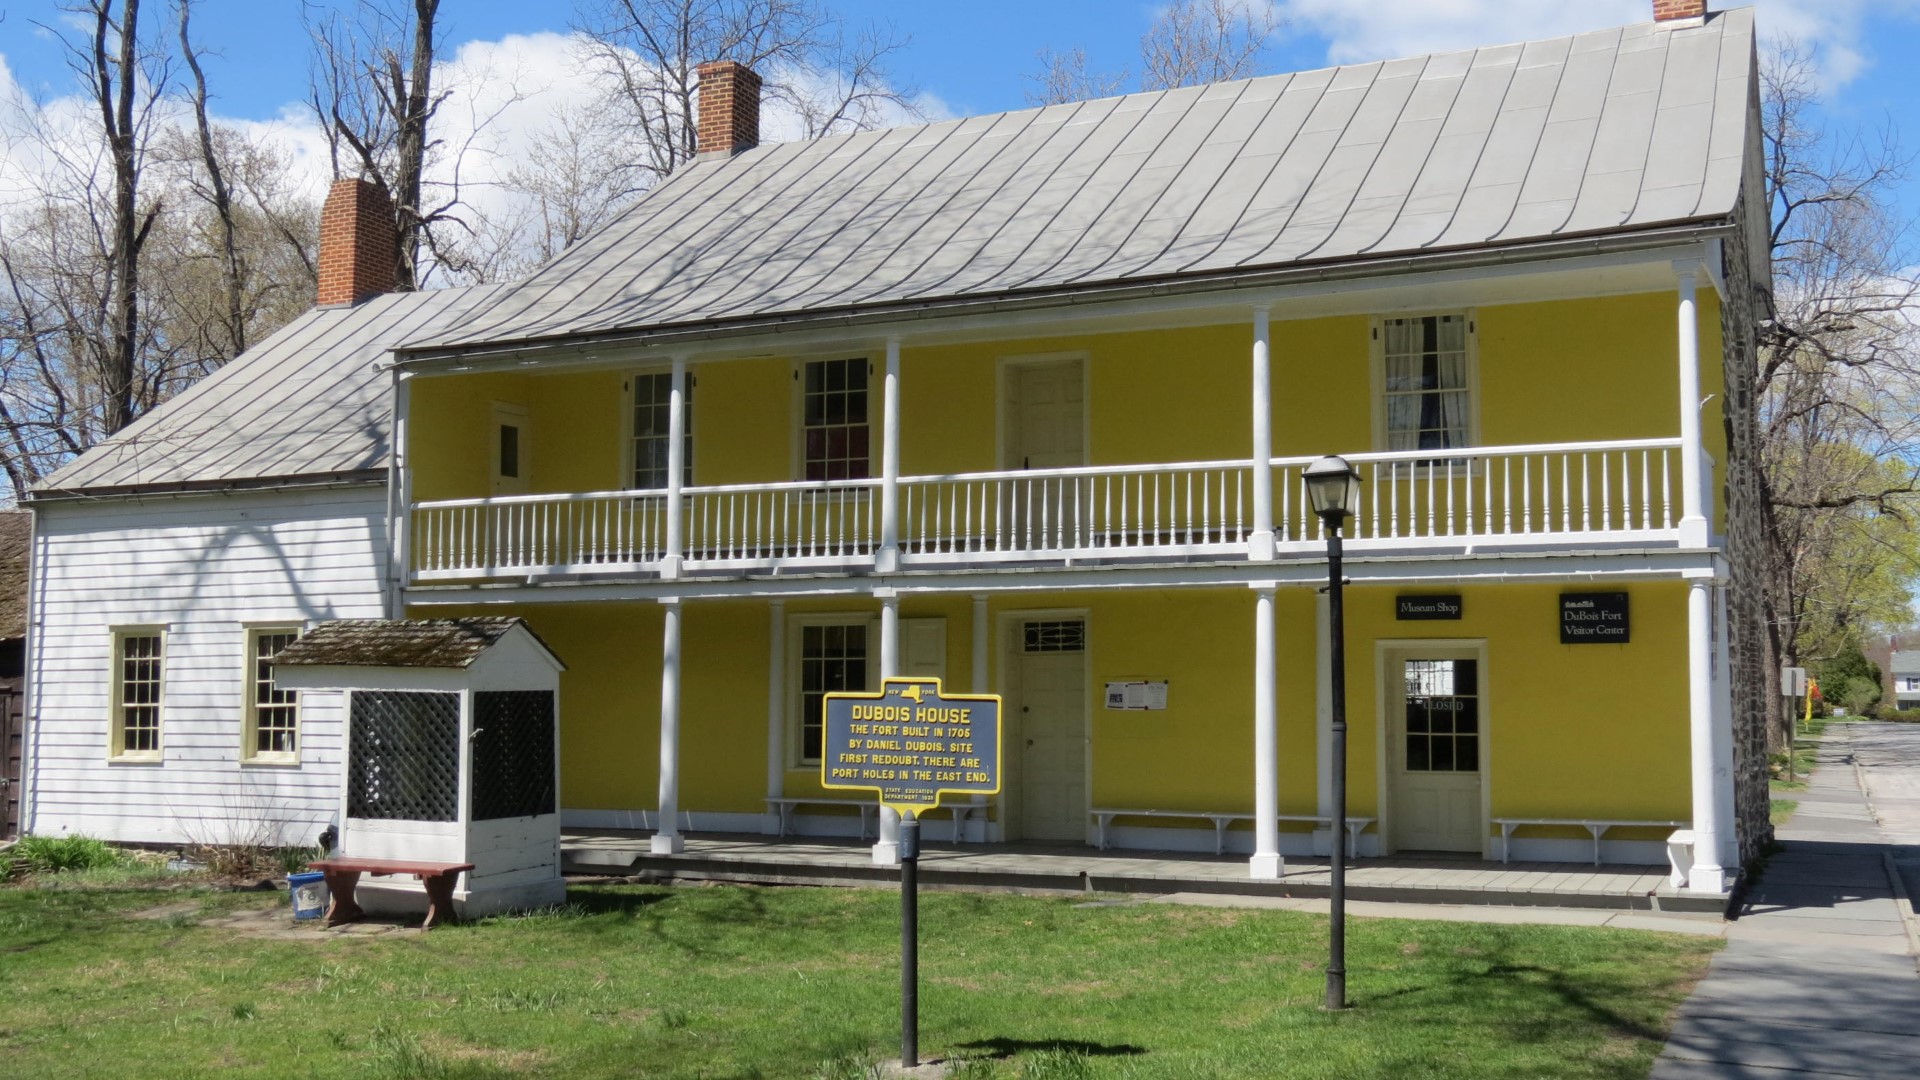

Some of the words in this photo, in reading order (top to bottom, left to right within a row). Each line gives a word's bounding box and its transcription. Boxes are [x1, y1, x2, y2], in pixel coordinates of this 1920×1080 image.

[1401, 603, 1436, 612] Museum
[1437, 602, 1458, 614] Shop
[1564, 610, 1599, 620] DuBois
[1601, 610, 1622, 620] Fort
[1565, 625, 1595, 635] Visitor
[1596, 624, 1625, 635] Center
[852, 705, 910, 722] DUBOIS
[916, 707, 971, 724] HOUSE
[850, 724, 868, 734] THE
[873, 725, 898, 735] FORT
[902, 727, 930, 736] BUILT
[934, 727, 943, 736] IN
[948, 728, 971, 738] 1705
[849, 739, 862, 749] BY
[866, 740, 901, 750] DANIEL
[905, 742, 945, 752] DUBOIS.
[950, 743, 973, 753] SITE
[839, 753, 868, 763] FIRST
[872, 755, 920, 765] REDOUBT.
[924, 756, 955, 767] THERE
[960, 758, 980, 768] ARE
[832, 769, 858, 778] PORT
[863, 769, 895, 779] HOLES
[899, 770, 909, 780] IN
[913, 771, 932, 780] THE
[936, 772, 961, 782] EAST
[966, 773, 990, 783] END.
